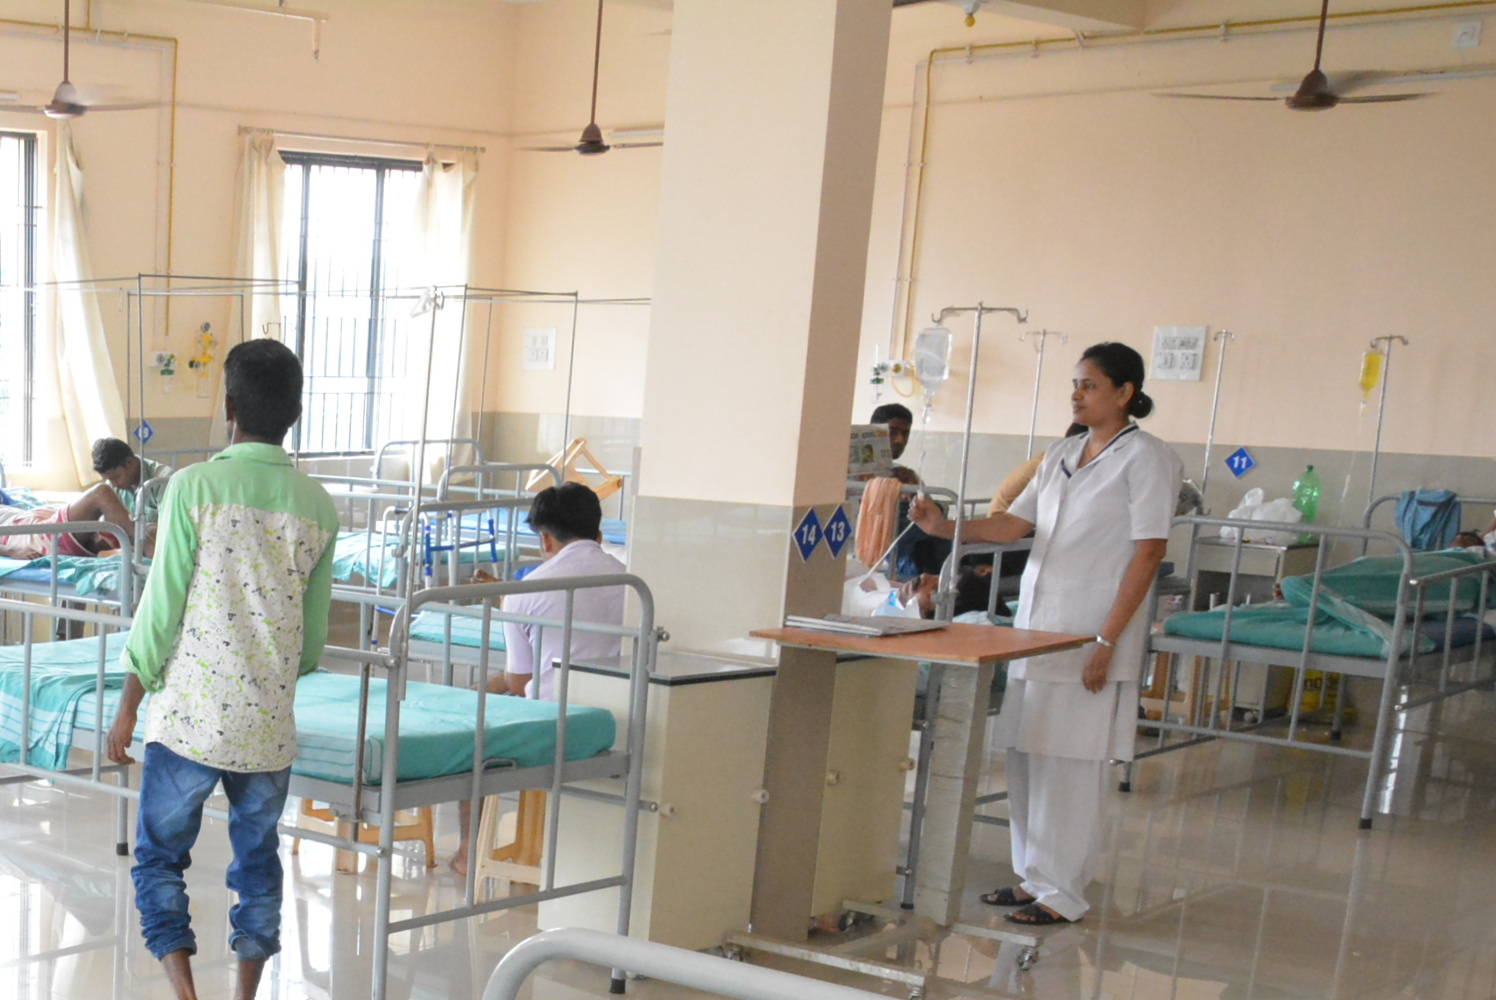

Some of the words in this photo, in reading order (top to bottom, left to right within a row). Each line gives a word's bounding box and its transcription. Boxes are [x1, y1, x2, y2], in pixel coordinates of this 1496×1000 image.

[1233, 456, 1247, 469] 11
[802, 524, 817, 545] 14
[831, 521, 845, 542] 13
